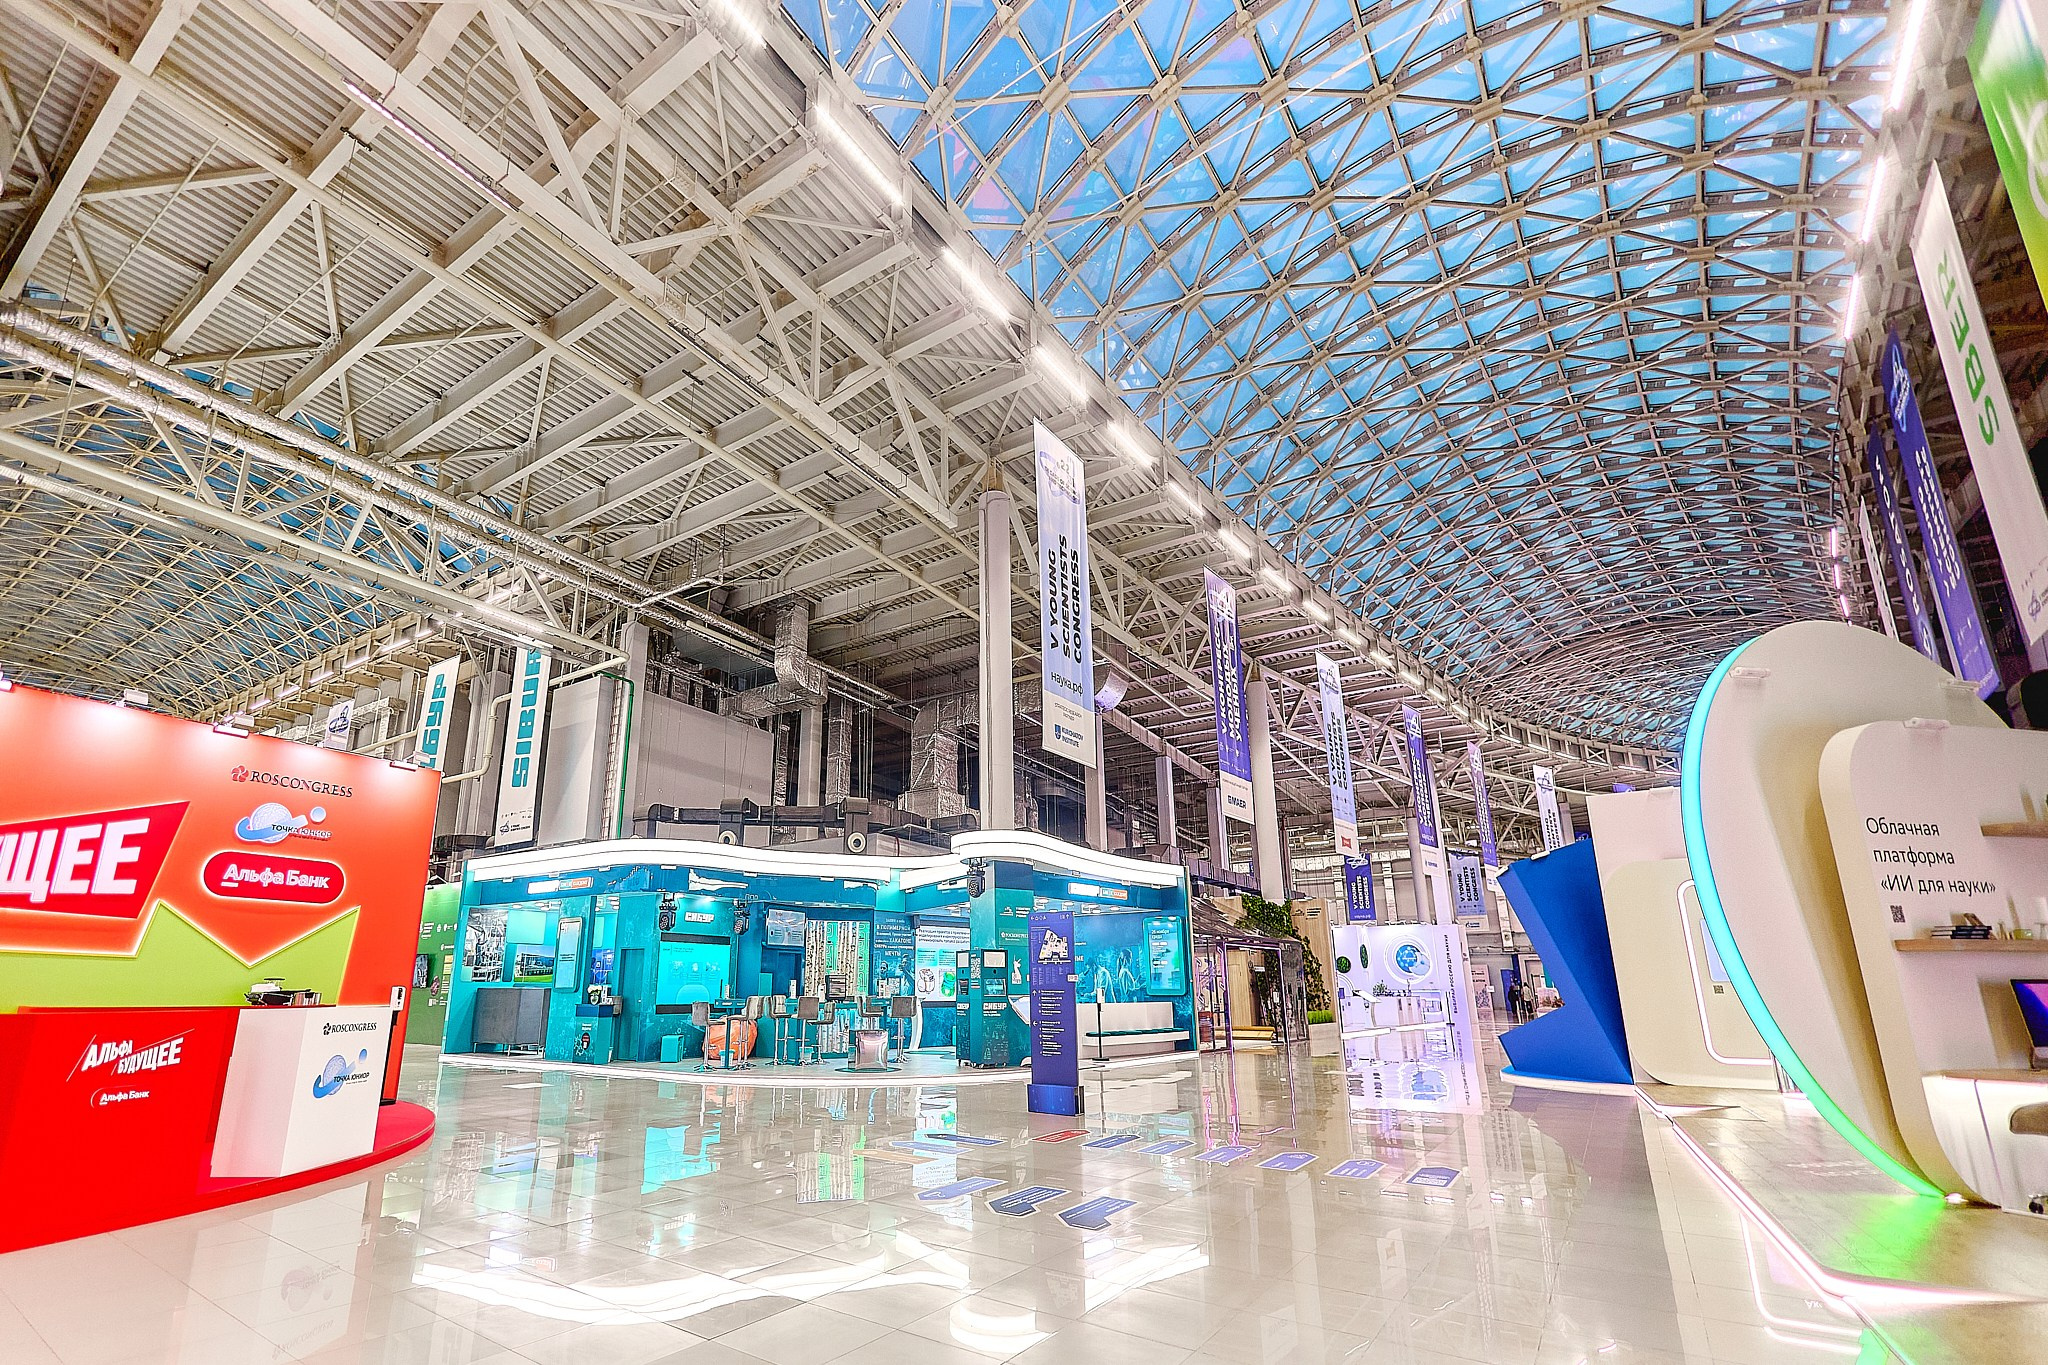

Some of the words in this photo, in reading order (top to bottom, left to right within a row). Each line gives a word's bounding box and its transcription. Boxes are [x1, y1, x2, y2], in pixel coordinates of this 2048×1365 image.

[1937, 250, 2000, 446] SBER
[1874, 454, 1921, 616] ROSATOM
[1048, 549, 1059, 632] YOUNG
[1059, 534, 1071, 659] SCIENTISTS
[1070, 549, 1083, 664] CONGRESS
[1050, 636, 1059, 650] V
[1051, 671, 1084, 696] наука.рф
[420, 673, 447, 769] БУР
[511, 648, 542, 788] SIBUR
[250, 770, 353, 798] ROSCONGRESS
[271, 823, 299, 834] ТОЧКА
[299, 827, 332, 838] ЮНИОР
[1866, 816, 1940, 837] Облачная
[0, 818, 151, 903] ЩЕЕ
[1873, 846, 1955, 868] платформа
[221, 863, 284, 888] Альфа
[286, 869, 331, 889] Банк
[1456, 874, 1465, 897] YOUNG
[1463, 866, 1473, 902] SCIENTISTS
[1470, 867, 1479, 902] CONGRESS
[1881, 874, 1914, 893] «ИИ
[1918, 879, 1946, 895] для
[1948, 880, 1997, 897] науки»
[1351, 882, 1359, 903] YOUNG
[1357, 875, 1365, 910] SCIENTISTS
[1363, 876, 1371, 909] CONGRESS
[331, 1022, 378, 1034] ROSCONGRESS
[81, 1040, 133, 1072] АЛЬФА
[117, 1037, 184, 1075] БУДУЩЕЕ
[99, 1093, 129, 1106] Альфа
[128, 1090, 150, 1100] Банк
